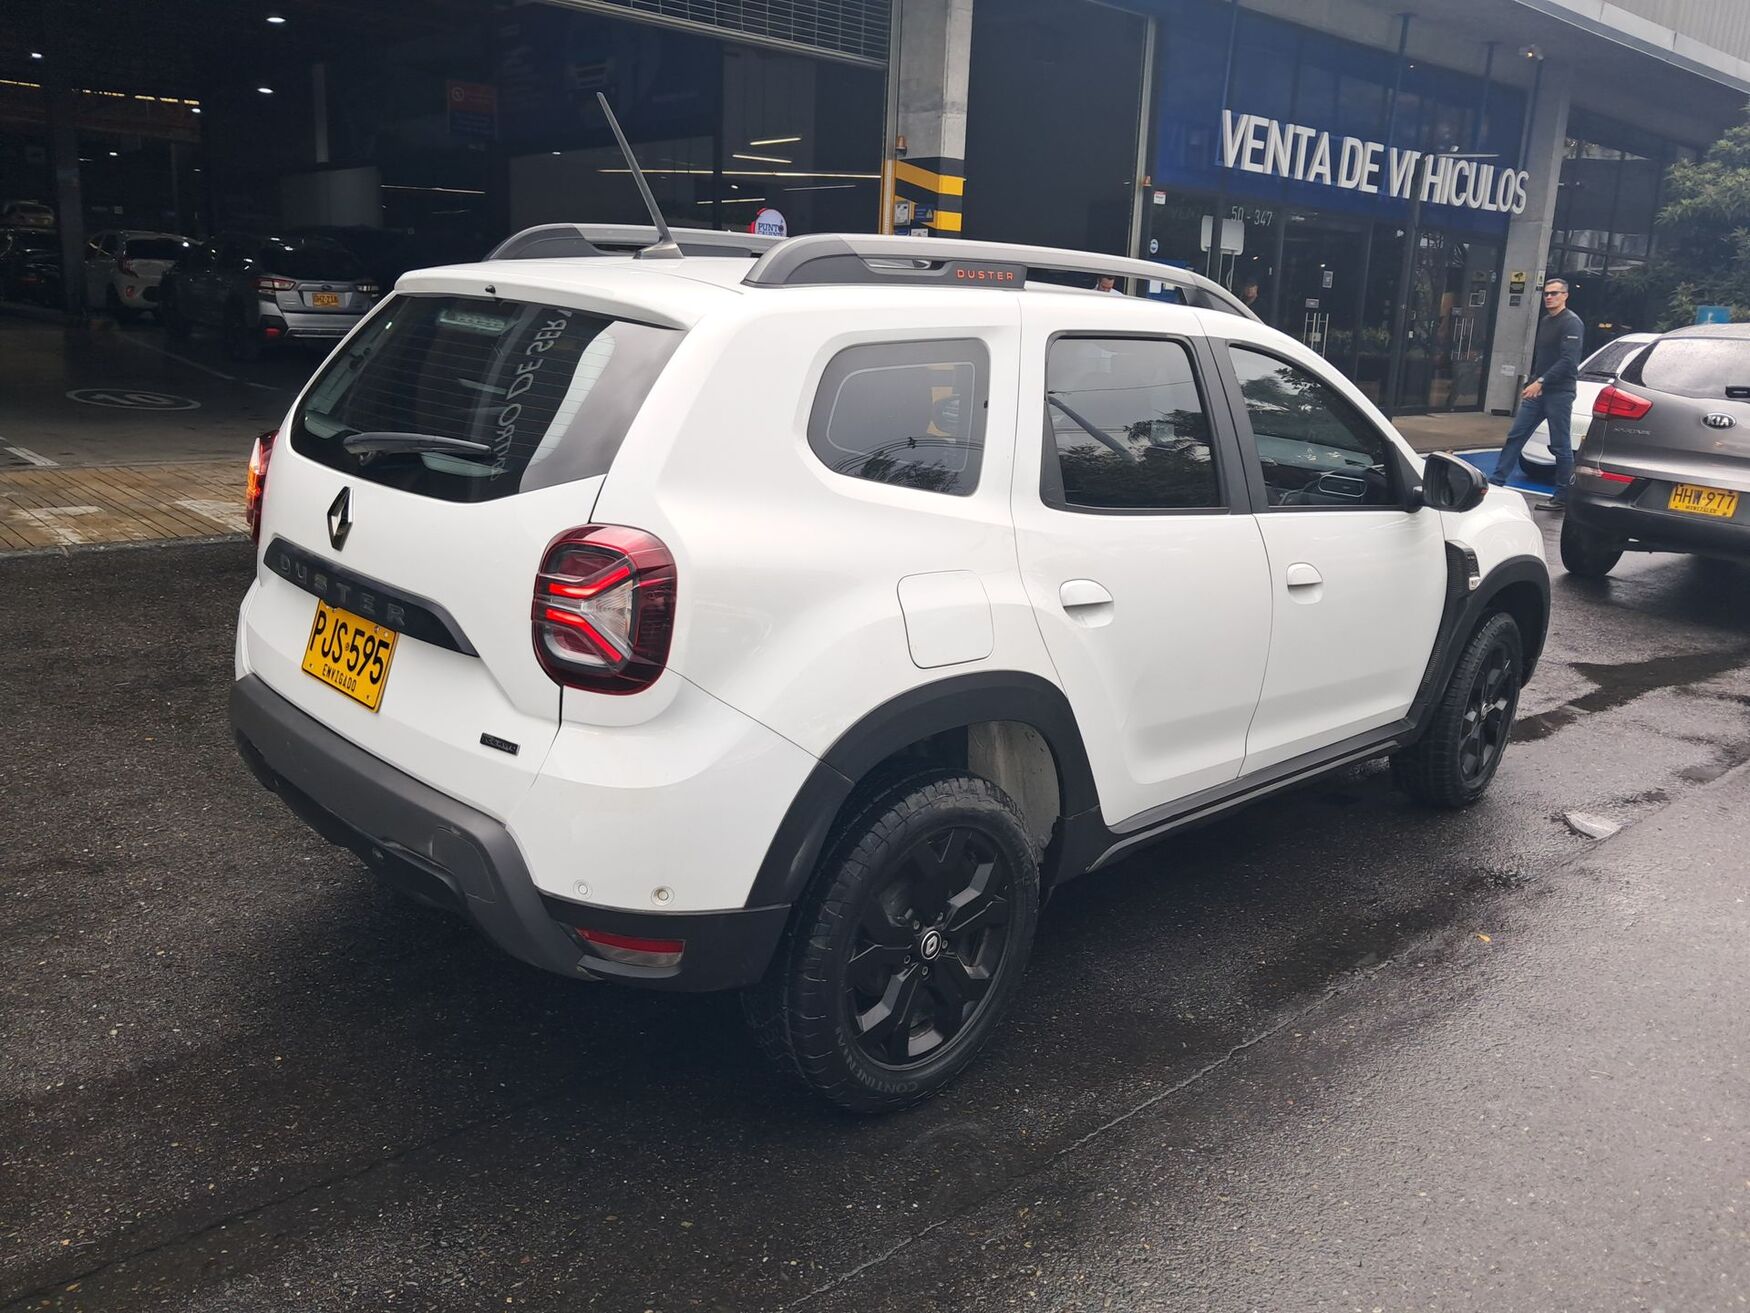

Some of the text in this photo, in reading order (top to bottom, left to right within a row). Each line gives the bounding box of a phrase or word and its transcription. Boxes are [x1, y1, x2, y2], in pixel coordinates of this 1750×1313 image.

[1222, 109, 1332, 185] VENTA
[1337, 136, 1384, 194] DE
[1231, 205, 1244, 222] 50
[1254, 209, 1273, 226] 347
[956, 269, 1014, 280] DUSTER
[1707, 415, 1730, 426] KIA
[279, 554, 406, 627] DUSTER
